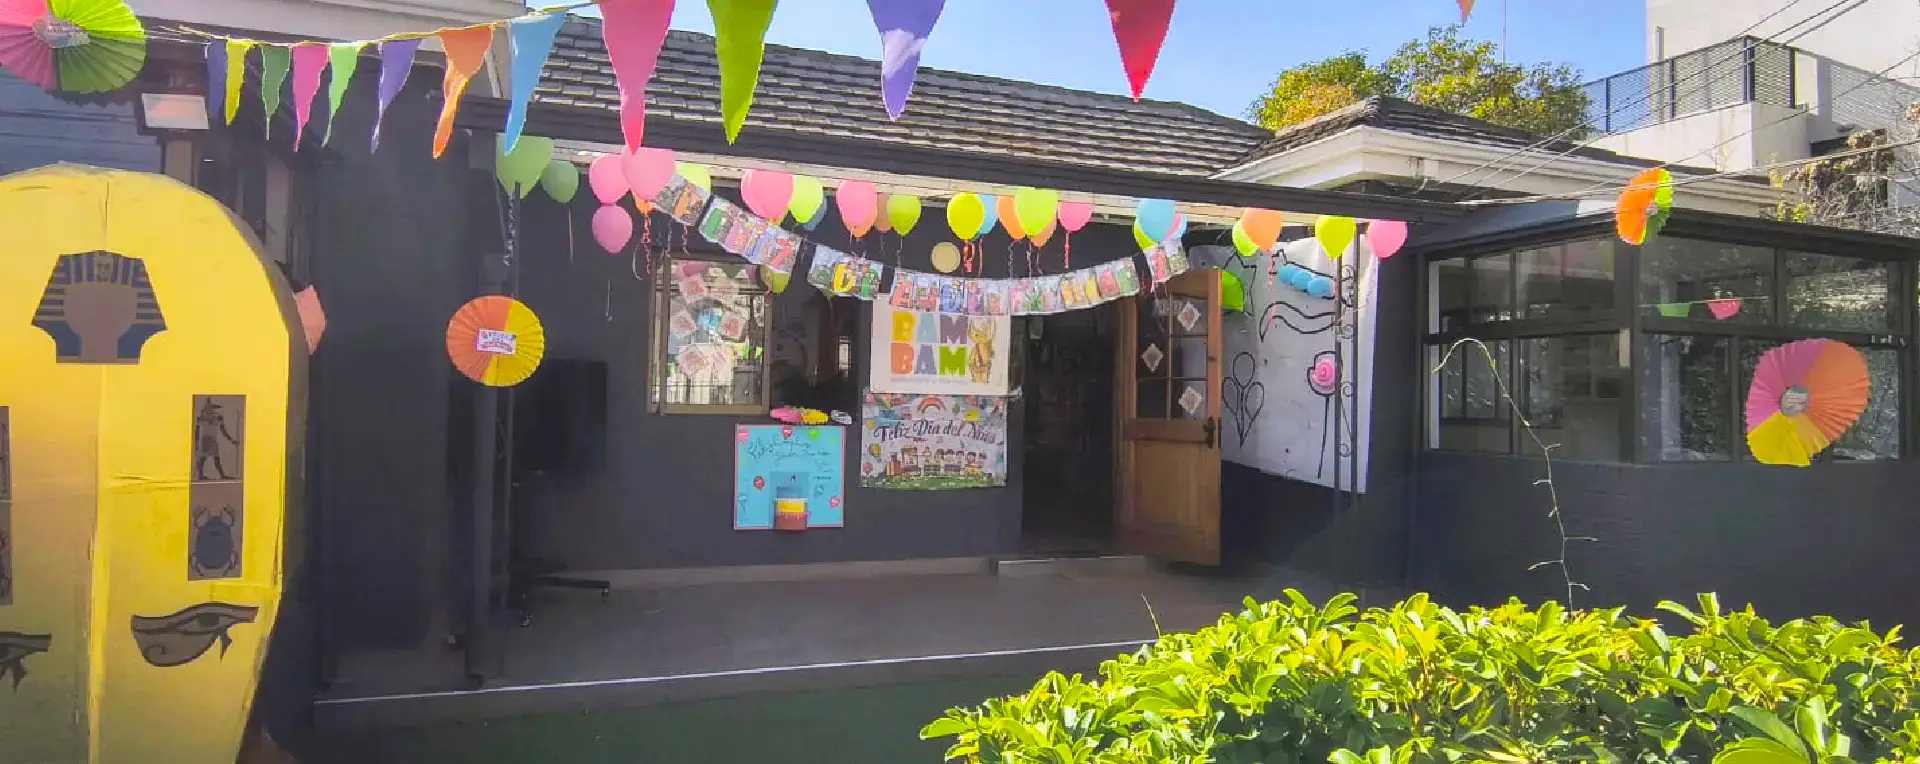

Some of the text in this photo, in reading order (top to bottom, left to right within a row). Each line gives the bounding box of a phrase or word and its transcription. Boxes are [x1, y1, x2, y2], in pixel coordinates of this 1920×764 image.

[892, 311, 968, 343] BAM
[890, 343, 968, 375] BAM
[874, 421, 912, 442] Feliz
[943, 419, 961, 436] del
